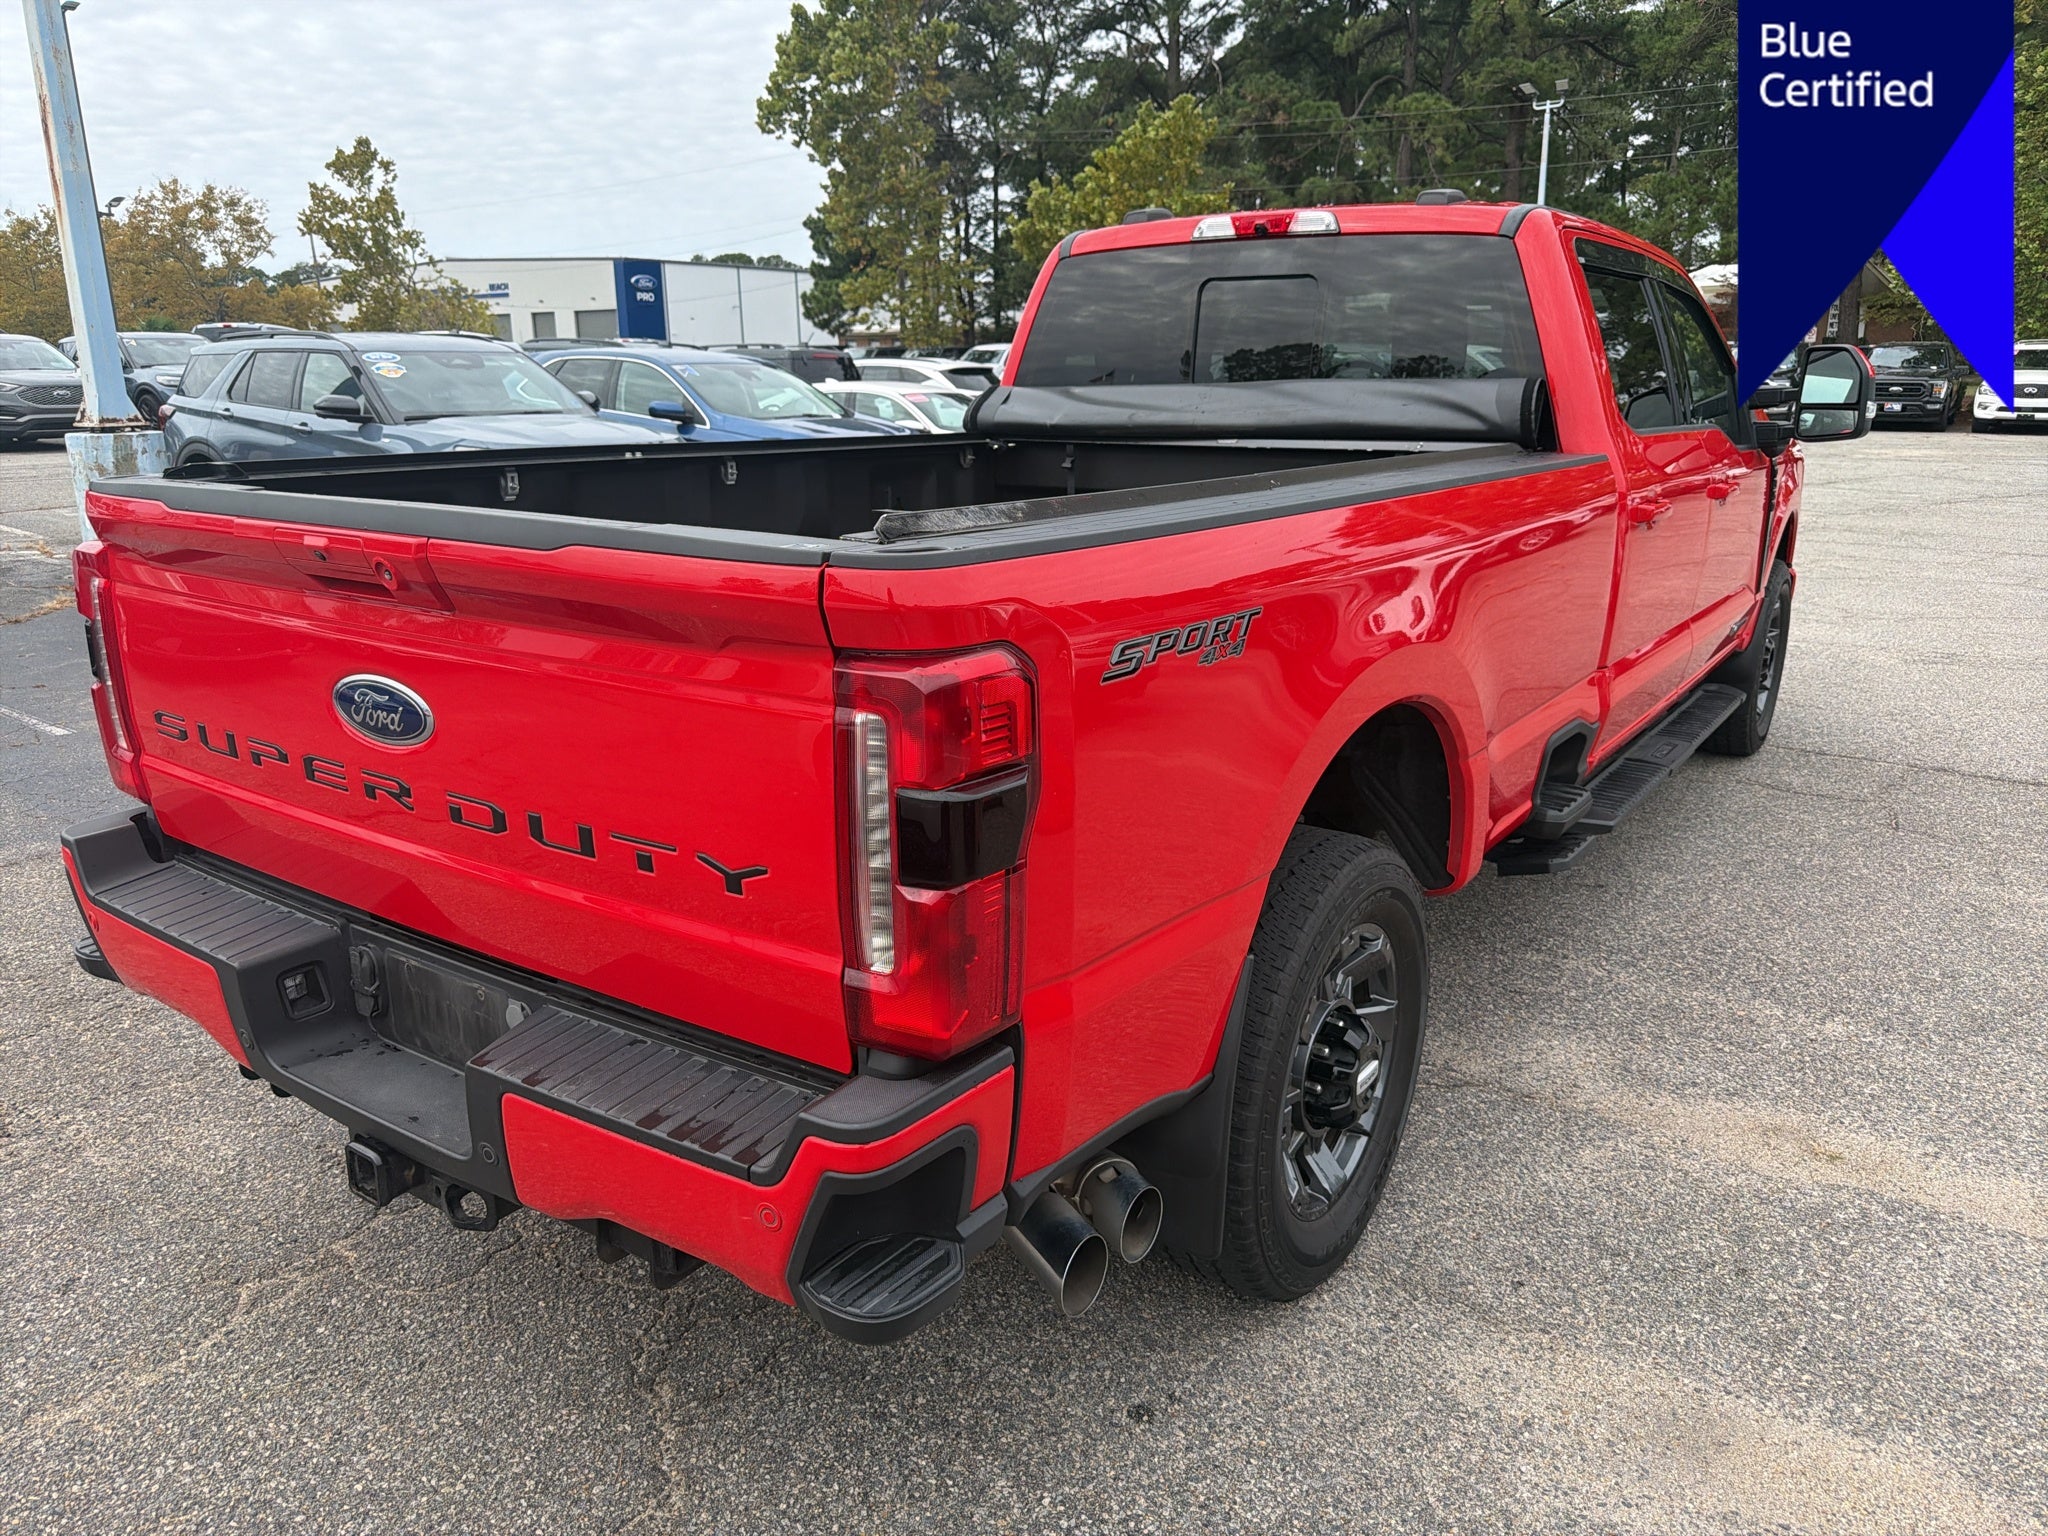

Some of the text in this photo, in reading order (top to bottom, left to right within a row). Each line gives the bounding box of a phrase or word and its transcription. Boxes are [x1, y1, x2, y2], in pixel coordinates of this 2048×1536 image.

[637, 292, 655, 302] PRO
[1101, 606, 1263, 685] SPORT
[351, 688, 404, 732] Ford
[153, 710, 769, 897] SUPER DUTY
